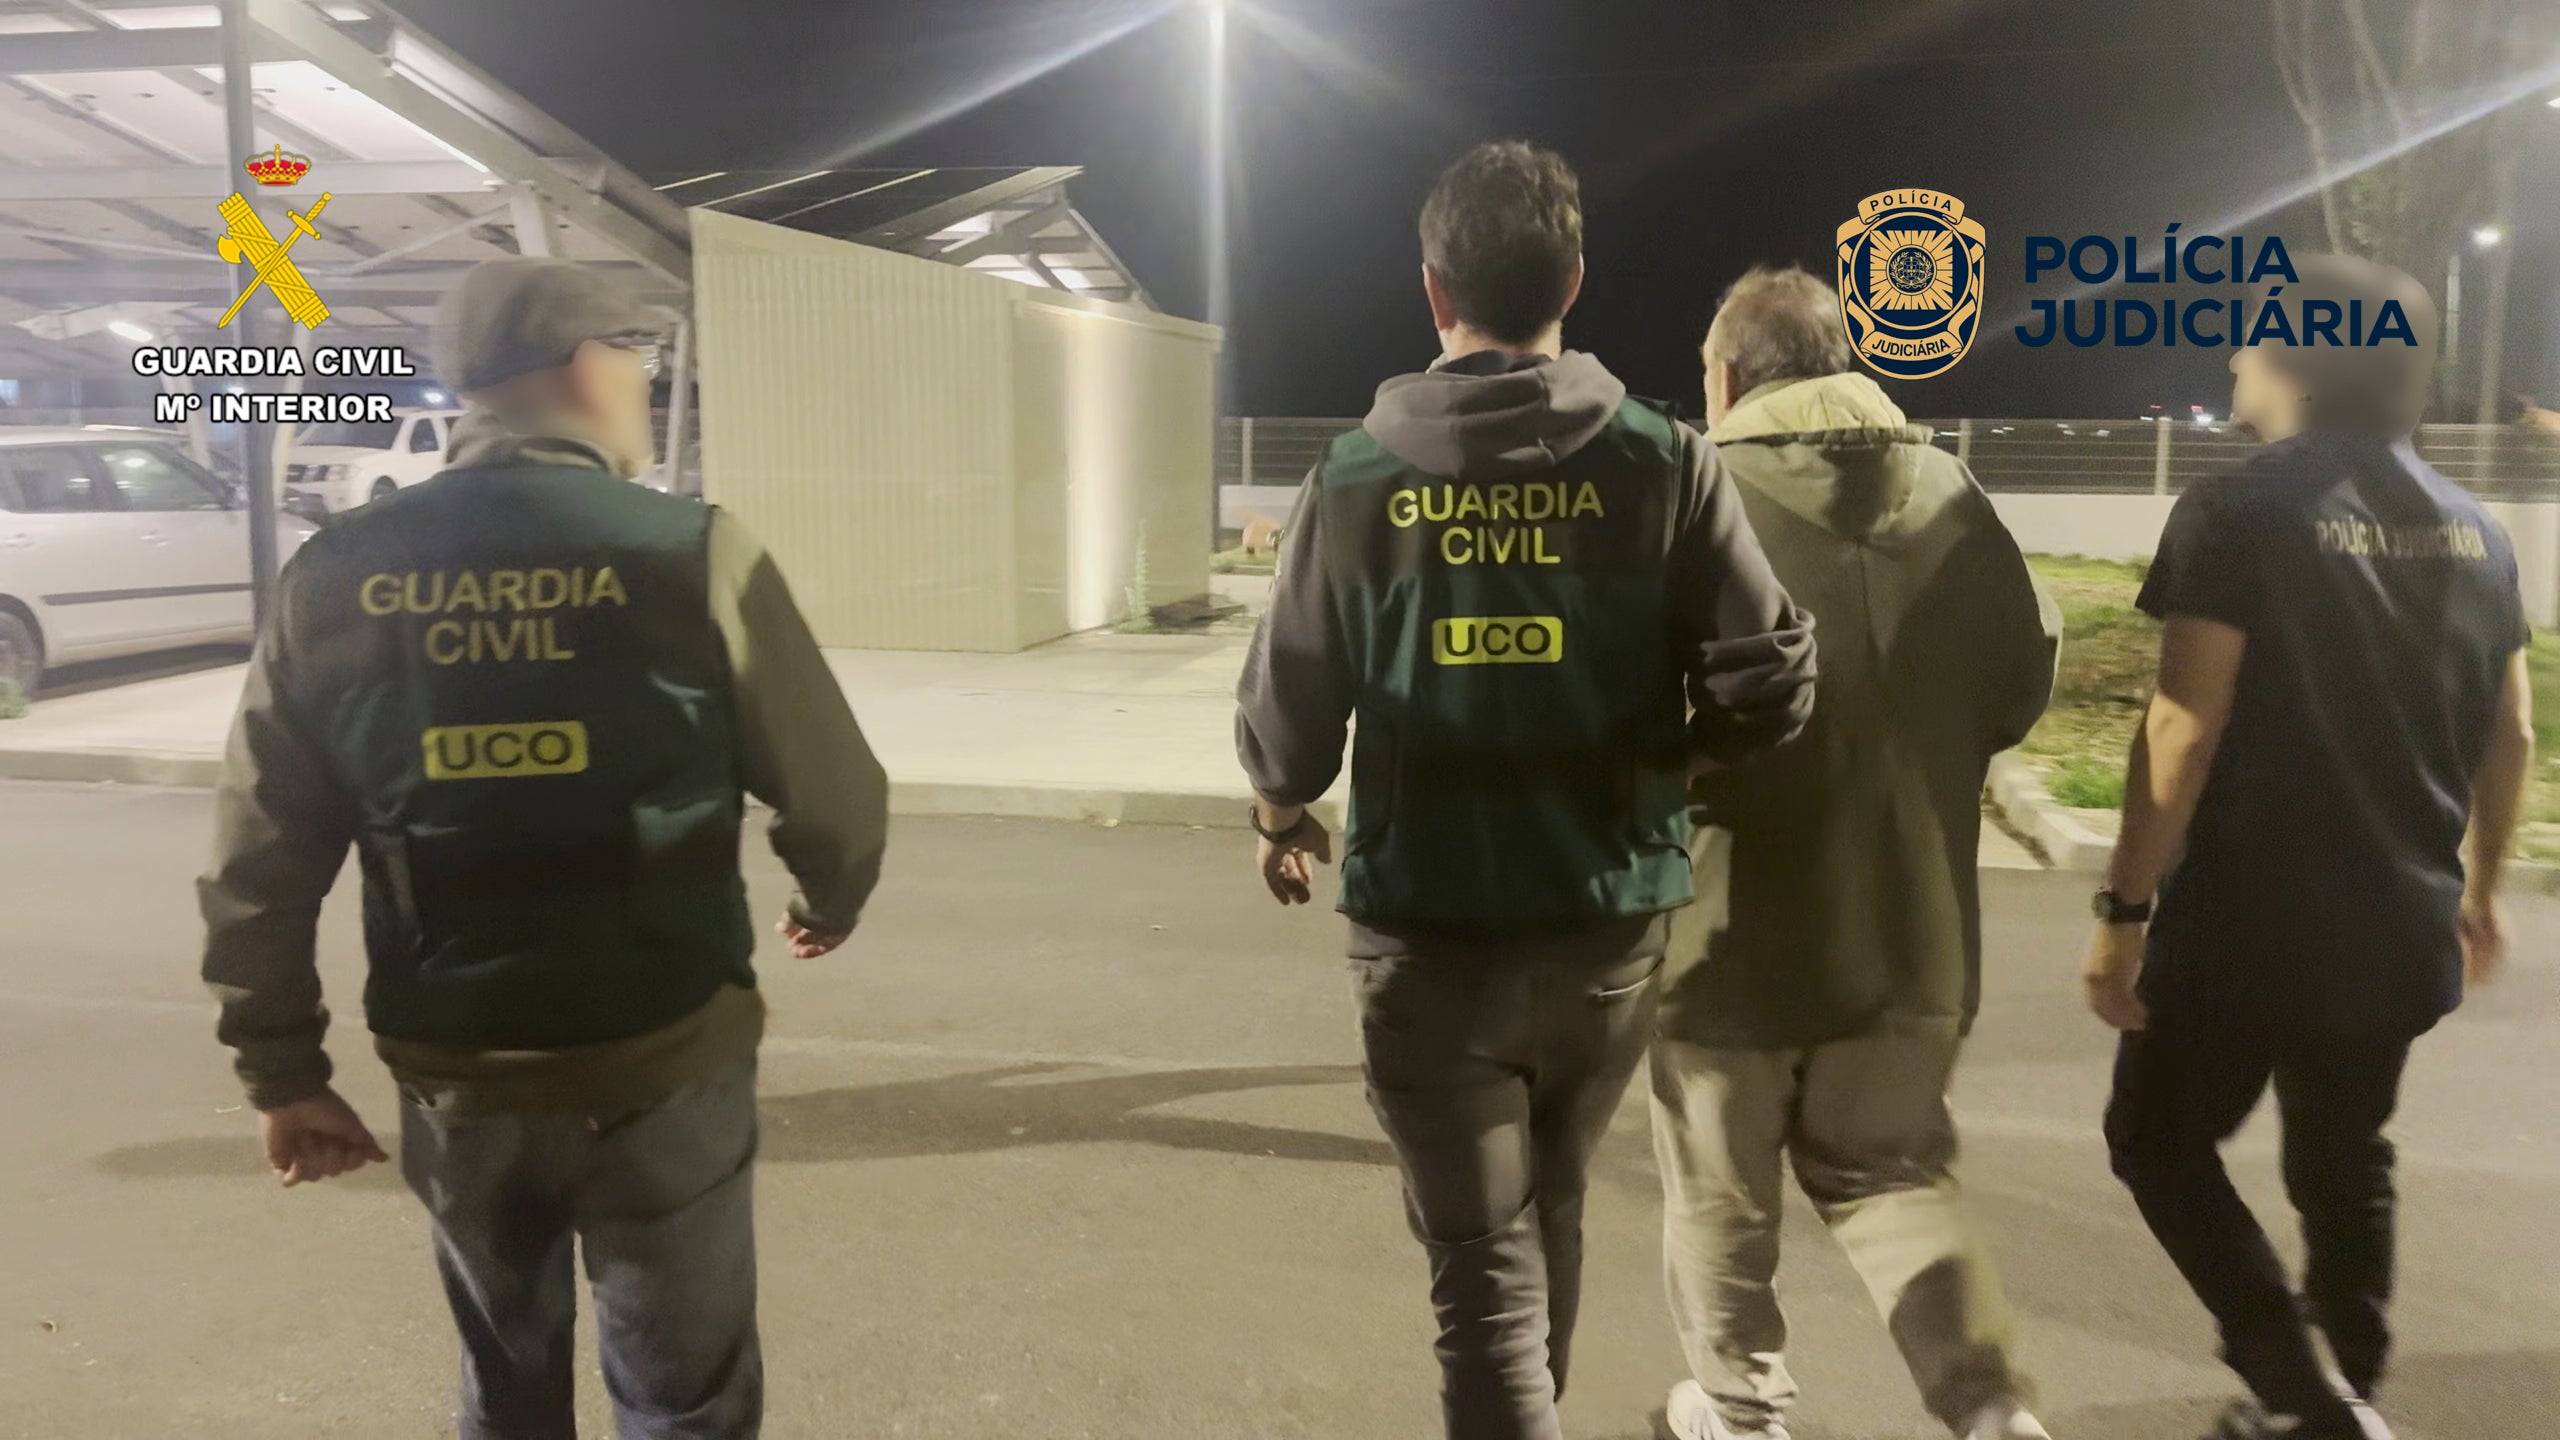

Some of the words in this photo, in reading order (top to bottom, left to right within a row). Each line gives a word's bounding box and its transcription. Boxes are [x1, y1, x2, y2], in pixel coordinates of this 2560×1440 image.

[1387, 481, 1605, 528] GUARDIA
[1440, 526, 1561, 565] CIVIL
[359, 565, 629, 616] GUARDIA
[425, 616, 576, 665] CIVIL
[1444, 622, 1552, 657] UCO
[436, 729, 573, 771] UCO
